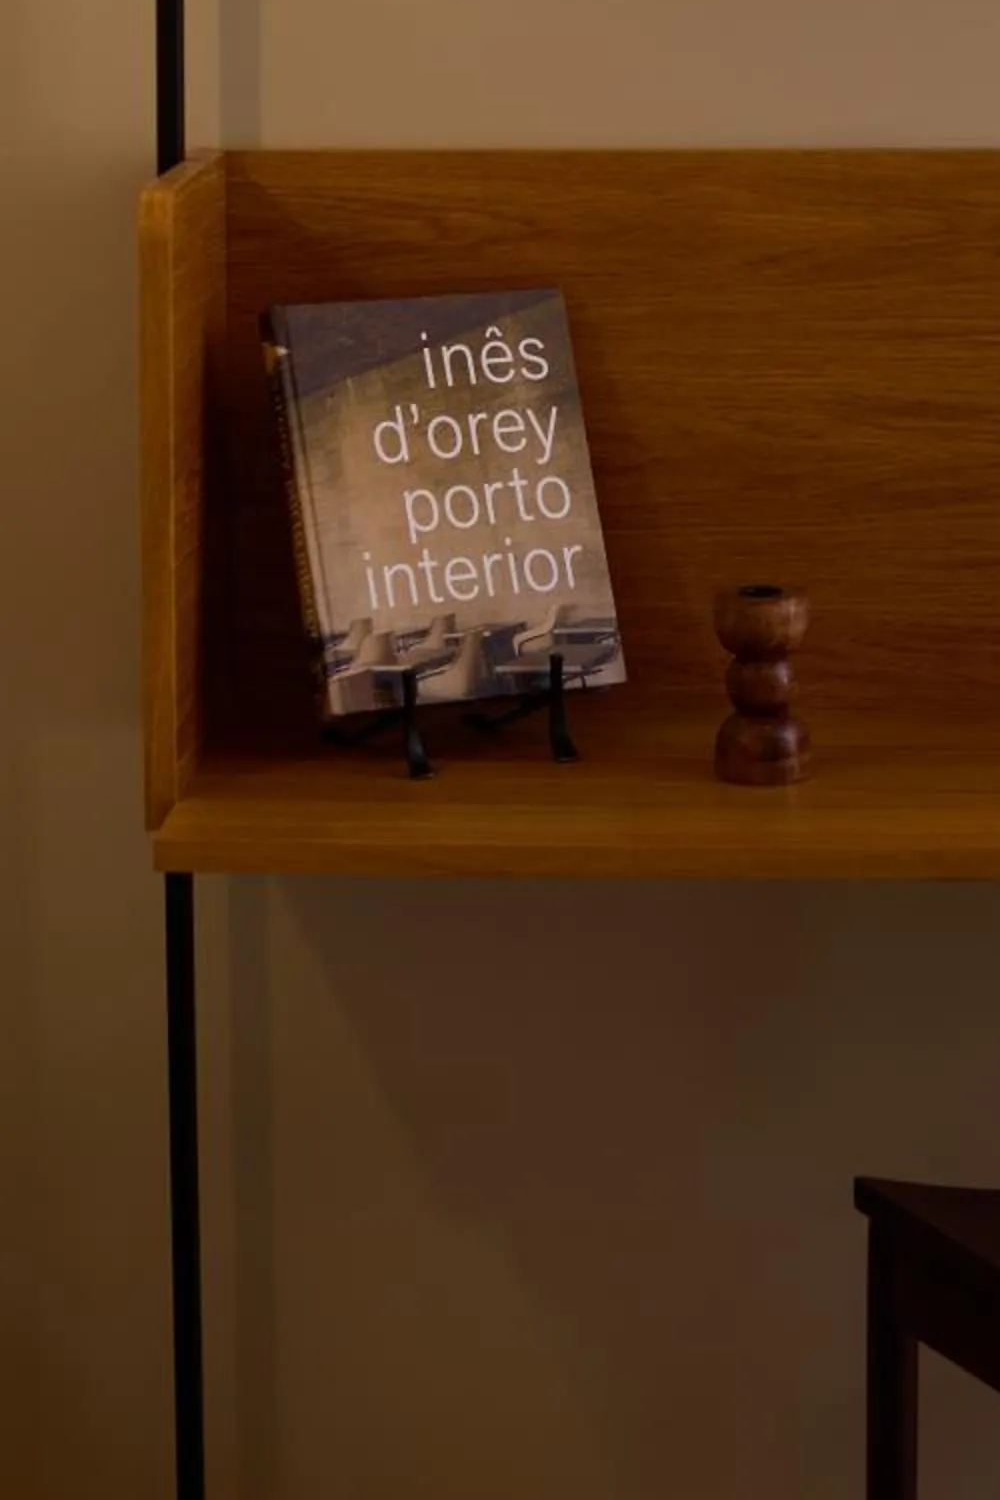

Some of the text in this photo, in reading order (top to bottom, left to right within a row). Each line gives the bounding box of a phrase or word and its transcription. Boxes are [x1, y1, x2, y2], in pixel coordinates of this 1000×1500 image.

[420, 326, 549, 388] inês
[373, 404, 558, 464] d'orey
[403, 468, 571, 543] porto
[362, 538, 582, 610] interior
